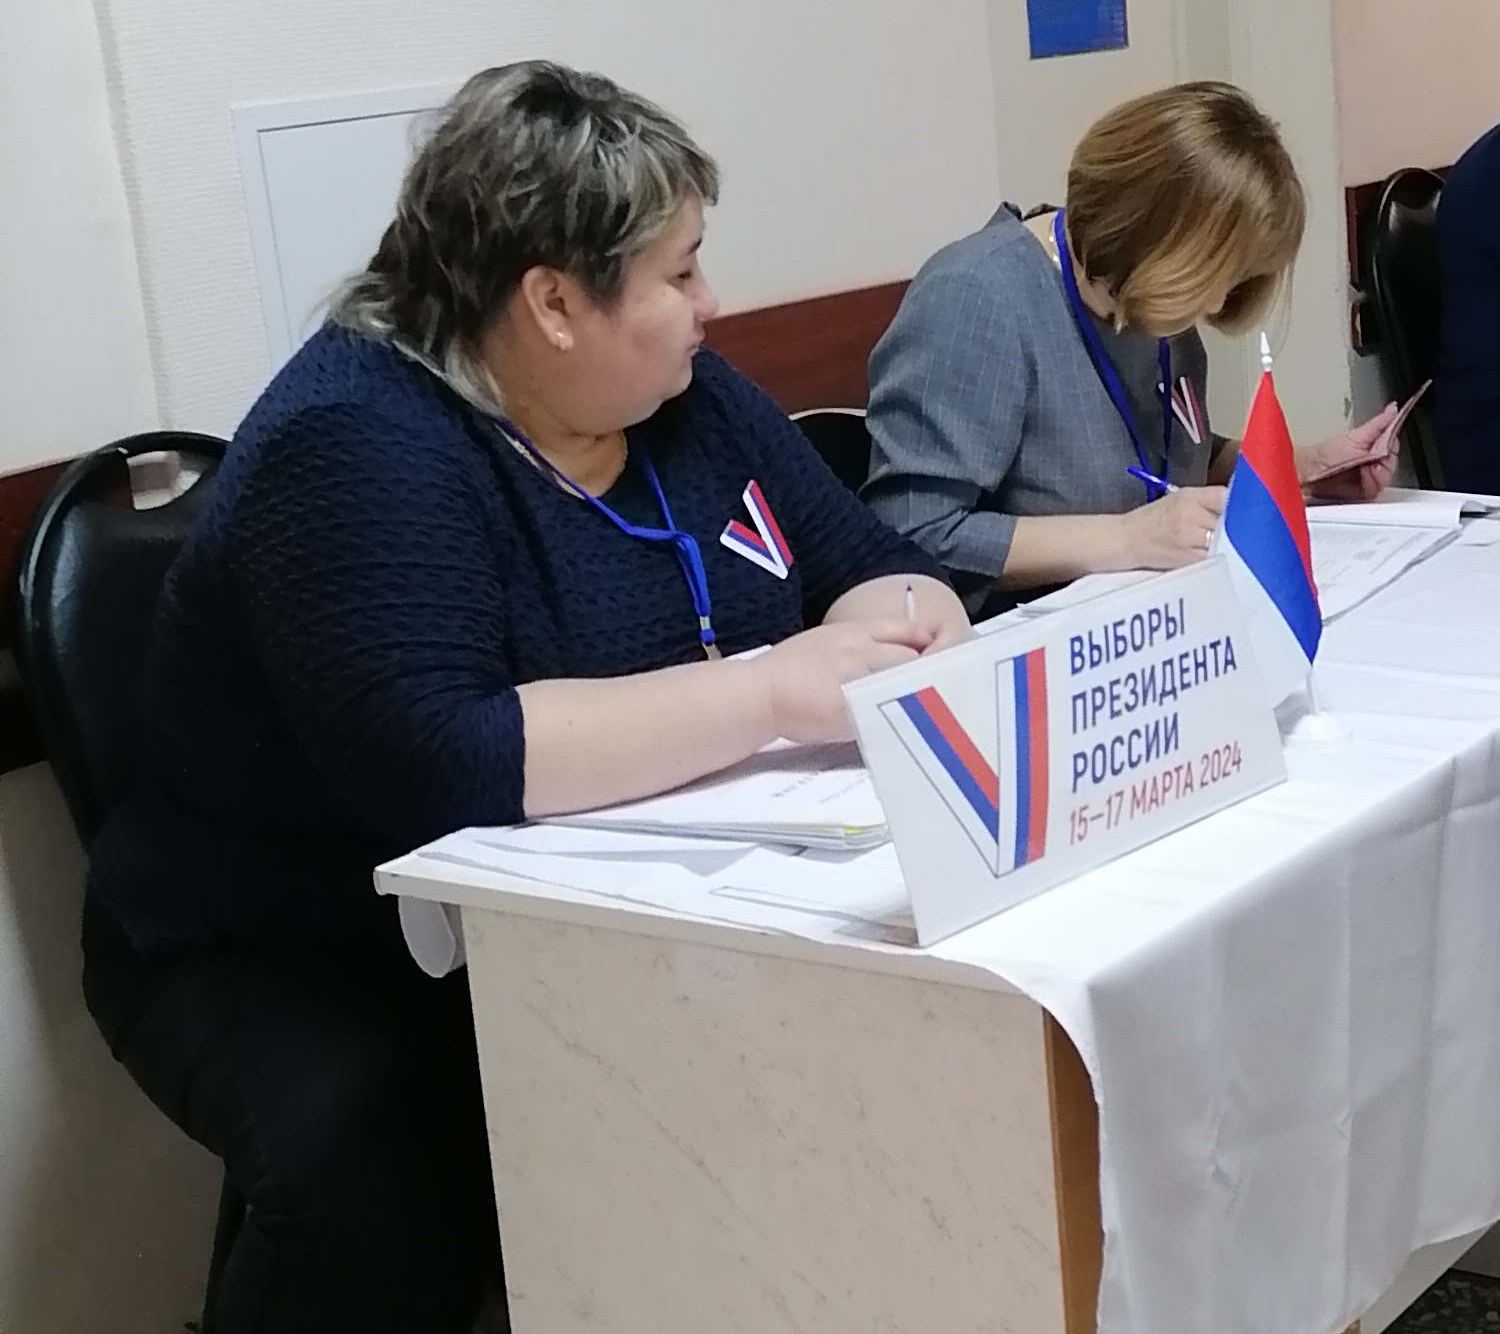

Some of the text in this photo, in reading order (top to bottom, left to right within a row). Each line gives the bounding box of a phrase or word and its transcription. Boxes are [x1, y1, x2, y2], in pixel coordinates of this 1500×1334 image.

[1069, 598, 1186, 675] ВЫБОРЫ
[1071, 635, 1238, 734] ПРЕЗИДЕНТА
[1071, 712, 1179, 793] РОССИИ
[1128, 768, 1195, 820] МАРТА
[1199, 740, 1243, 789] 2024
